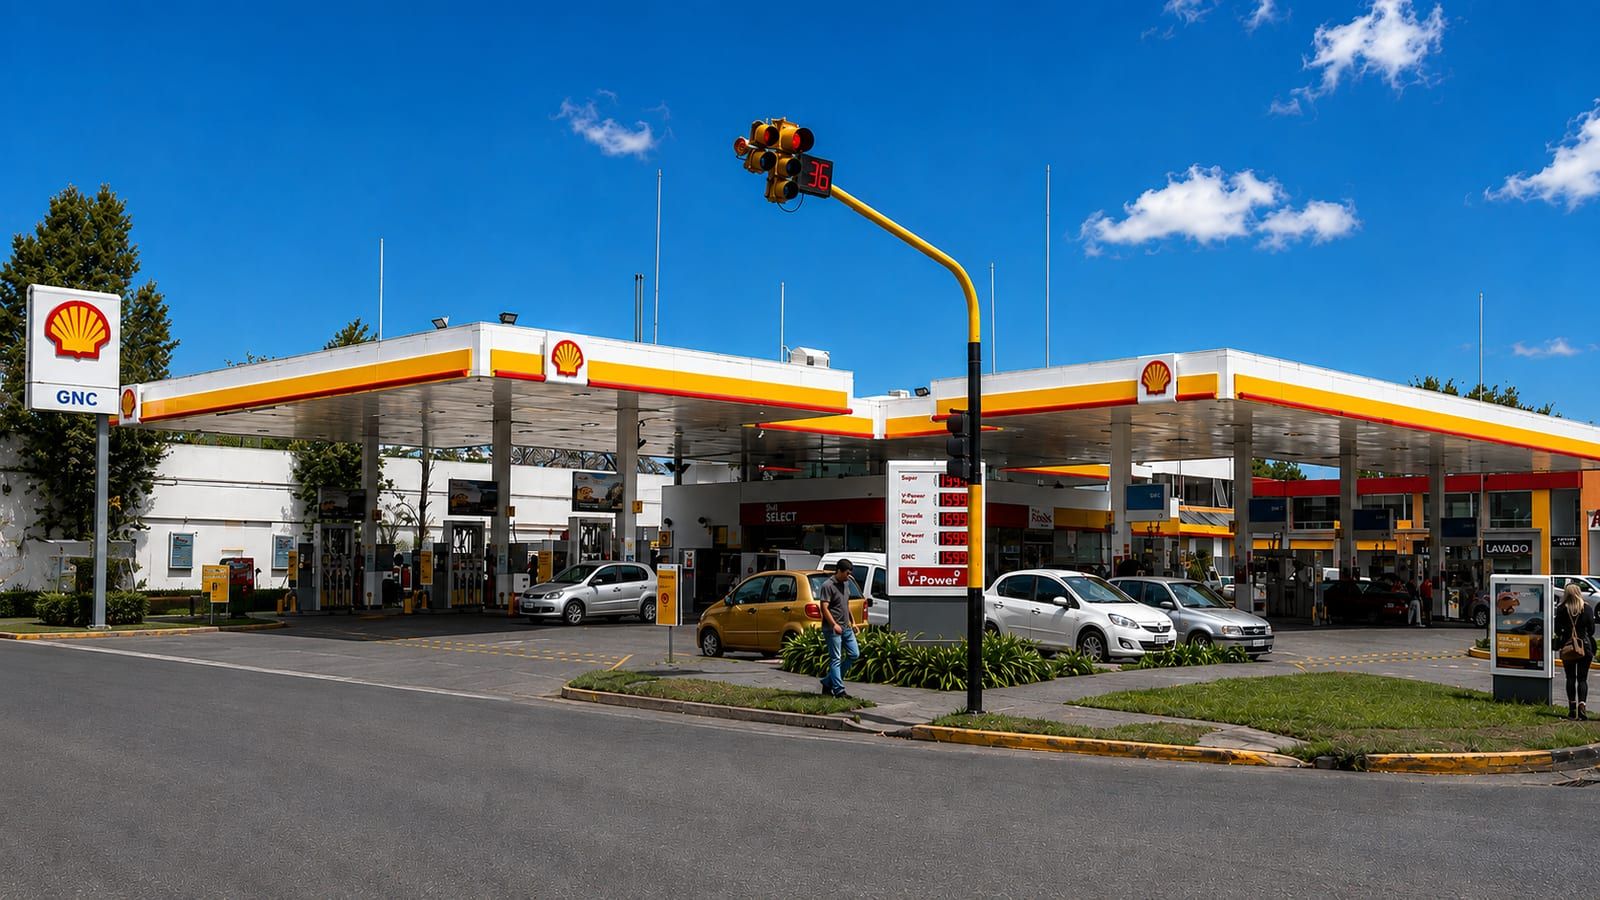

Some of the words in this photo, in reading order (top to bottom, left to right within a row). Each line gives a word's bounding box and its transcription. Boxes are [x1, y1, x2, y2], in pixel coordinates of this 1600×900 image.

[808, 161, 829, 190] 36
[56, 390, 98, 406] GNC
[766, 511, 797, 522] SELECT
[1486, 544, 1529, 553] LAVADO
[907, 575, 959, 585] V-Power
